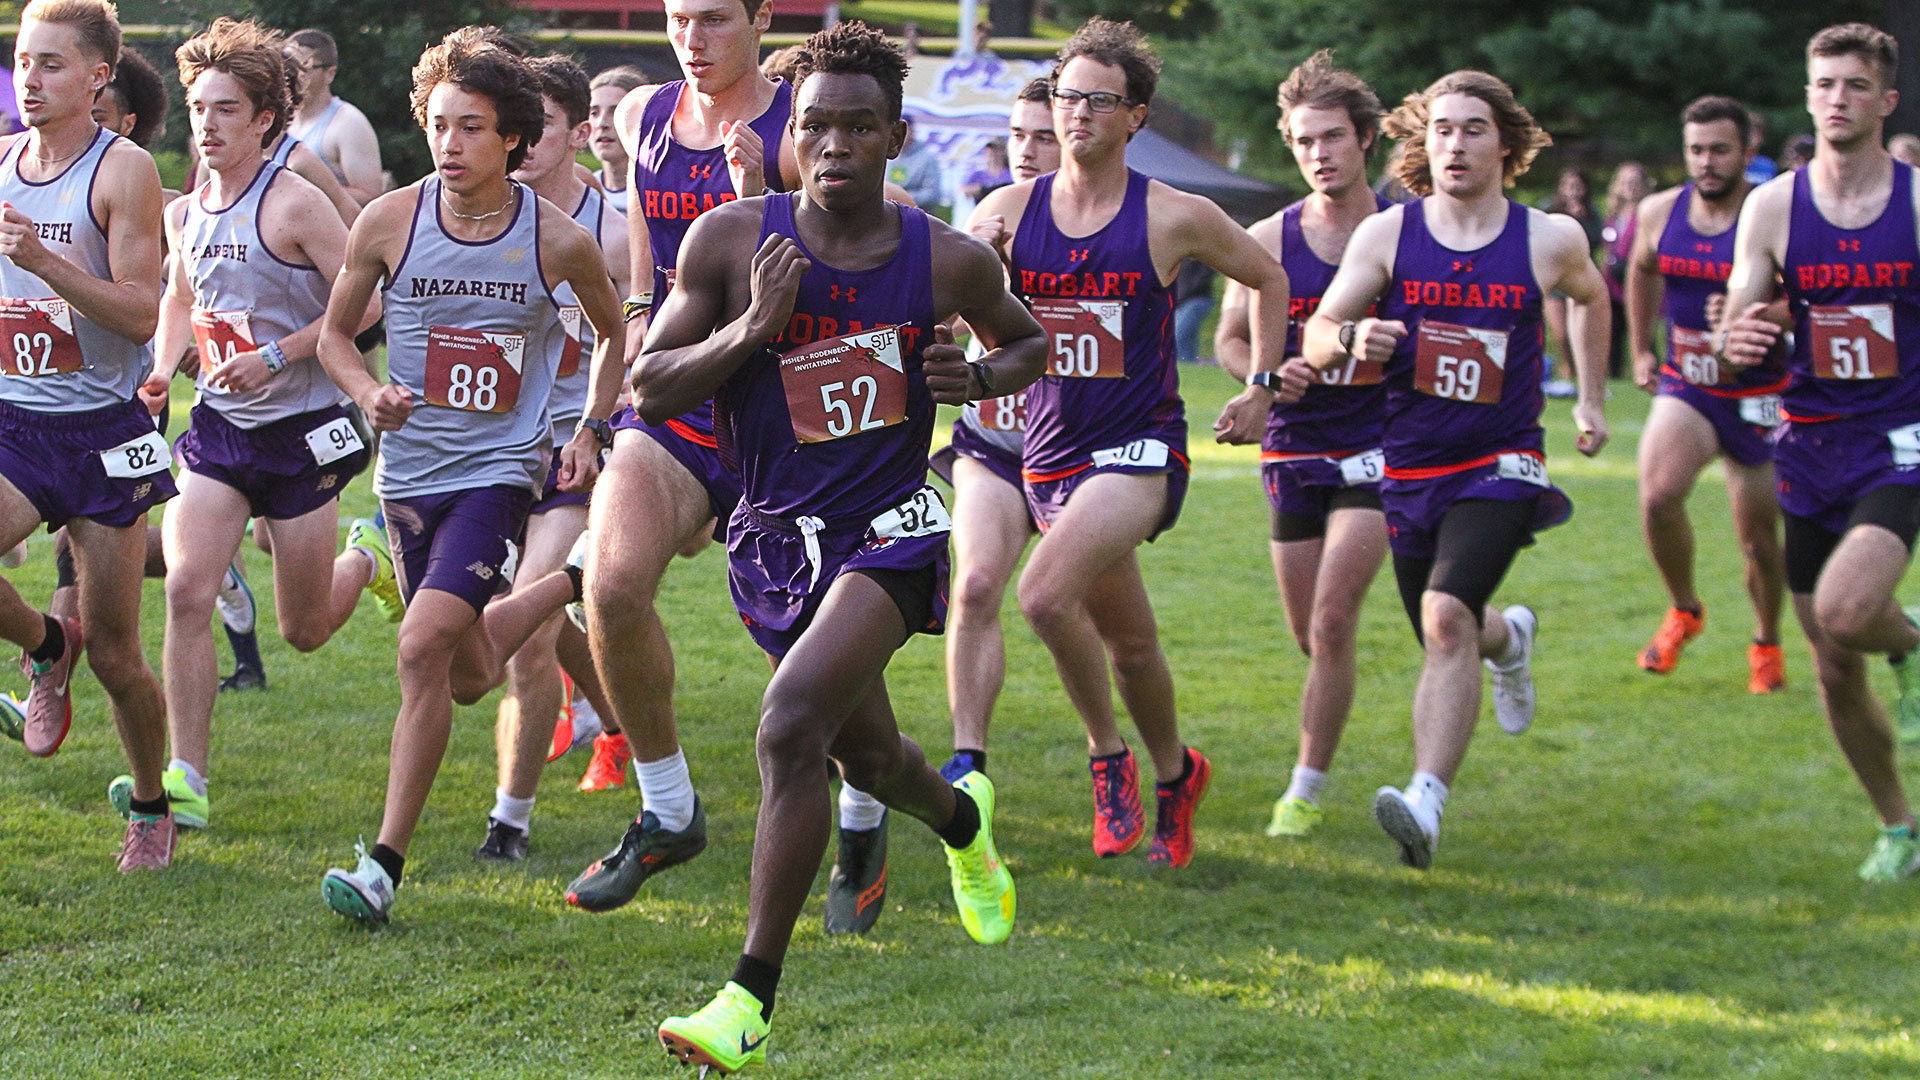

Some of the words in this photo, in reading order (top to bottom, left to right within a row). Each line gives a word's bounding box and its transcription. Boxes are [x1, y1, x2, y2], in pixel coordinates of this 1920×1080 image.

[644, 189, 738, 220] HOBA
[1657, 253, 1734, 281] HOBAR
[1796, 261, 1914, 290] HOBART
[411, 277, 528, 305] NAZARETH
[1020, 269, 1142, 297] HOBART
[1403, 279, 1527, 310] HOBART
[13, 331, 59, 377] 82
[503, 336, 523, 352] SJF
[781, 355, 806, 366] FISHER
[809, 346, 851, 360] RODENBECK
[870, 331, 896, 351] SJF
[1055, 332, 1099, 378] 50
[794, 356, 841, 372] INVITATIONAL
[1682, 352, 1719, 386] 60
[1829, 336, 1875, 380] 51
[447, 363, 499, 411] 88
[1433, 354, 1483, 401] 59
[820, 375, 885, 437] 52
[328, 424, 358, 451] 94
[125, 443, 158, 470] 82
[895, 491, 938, 533] 52
